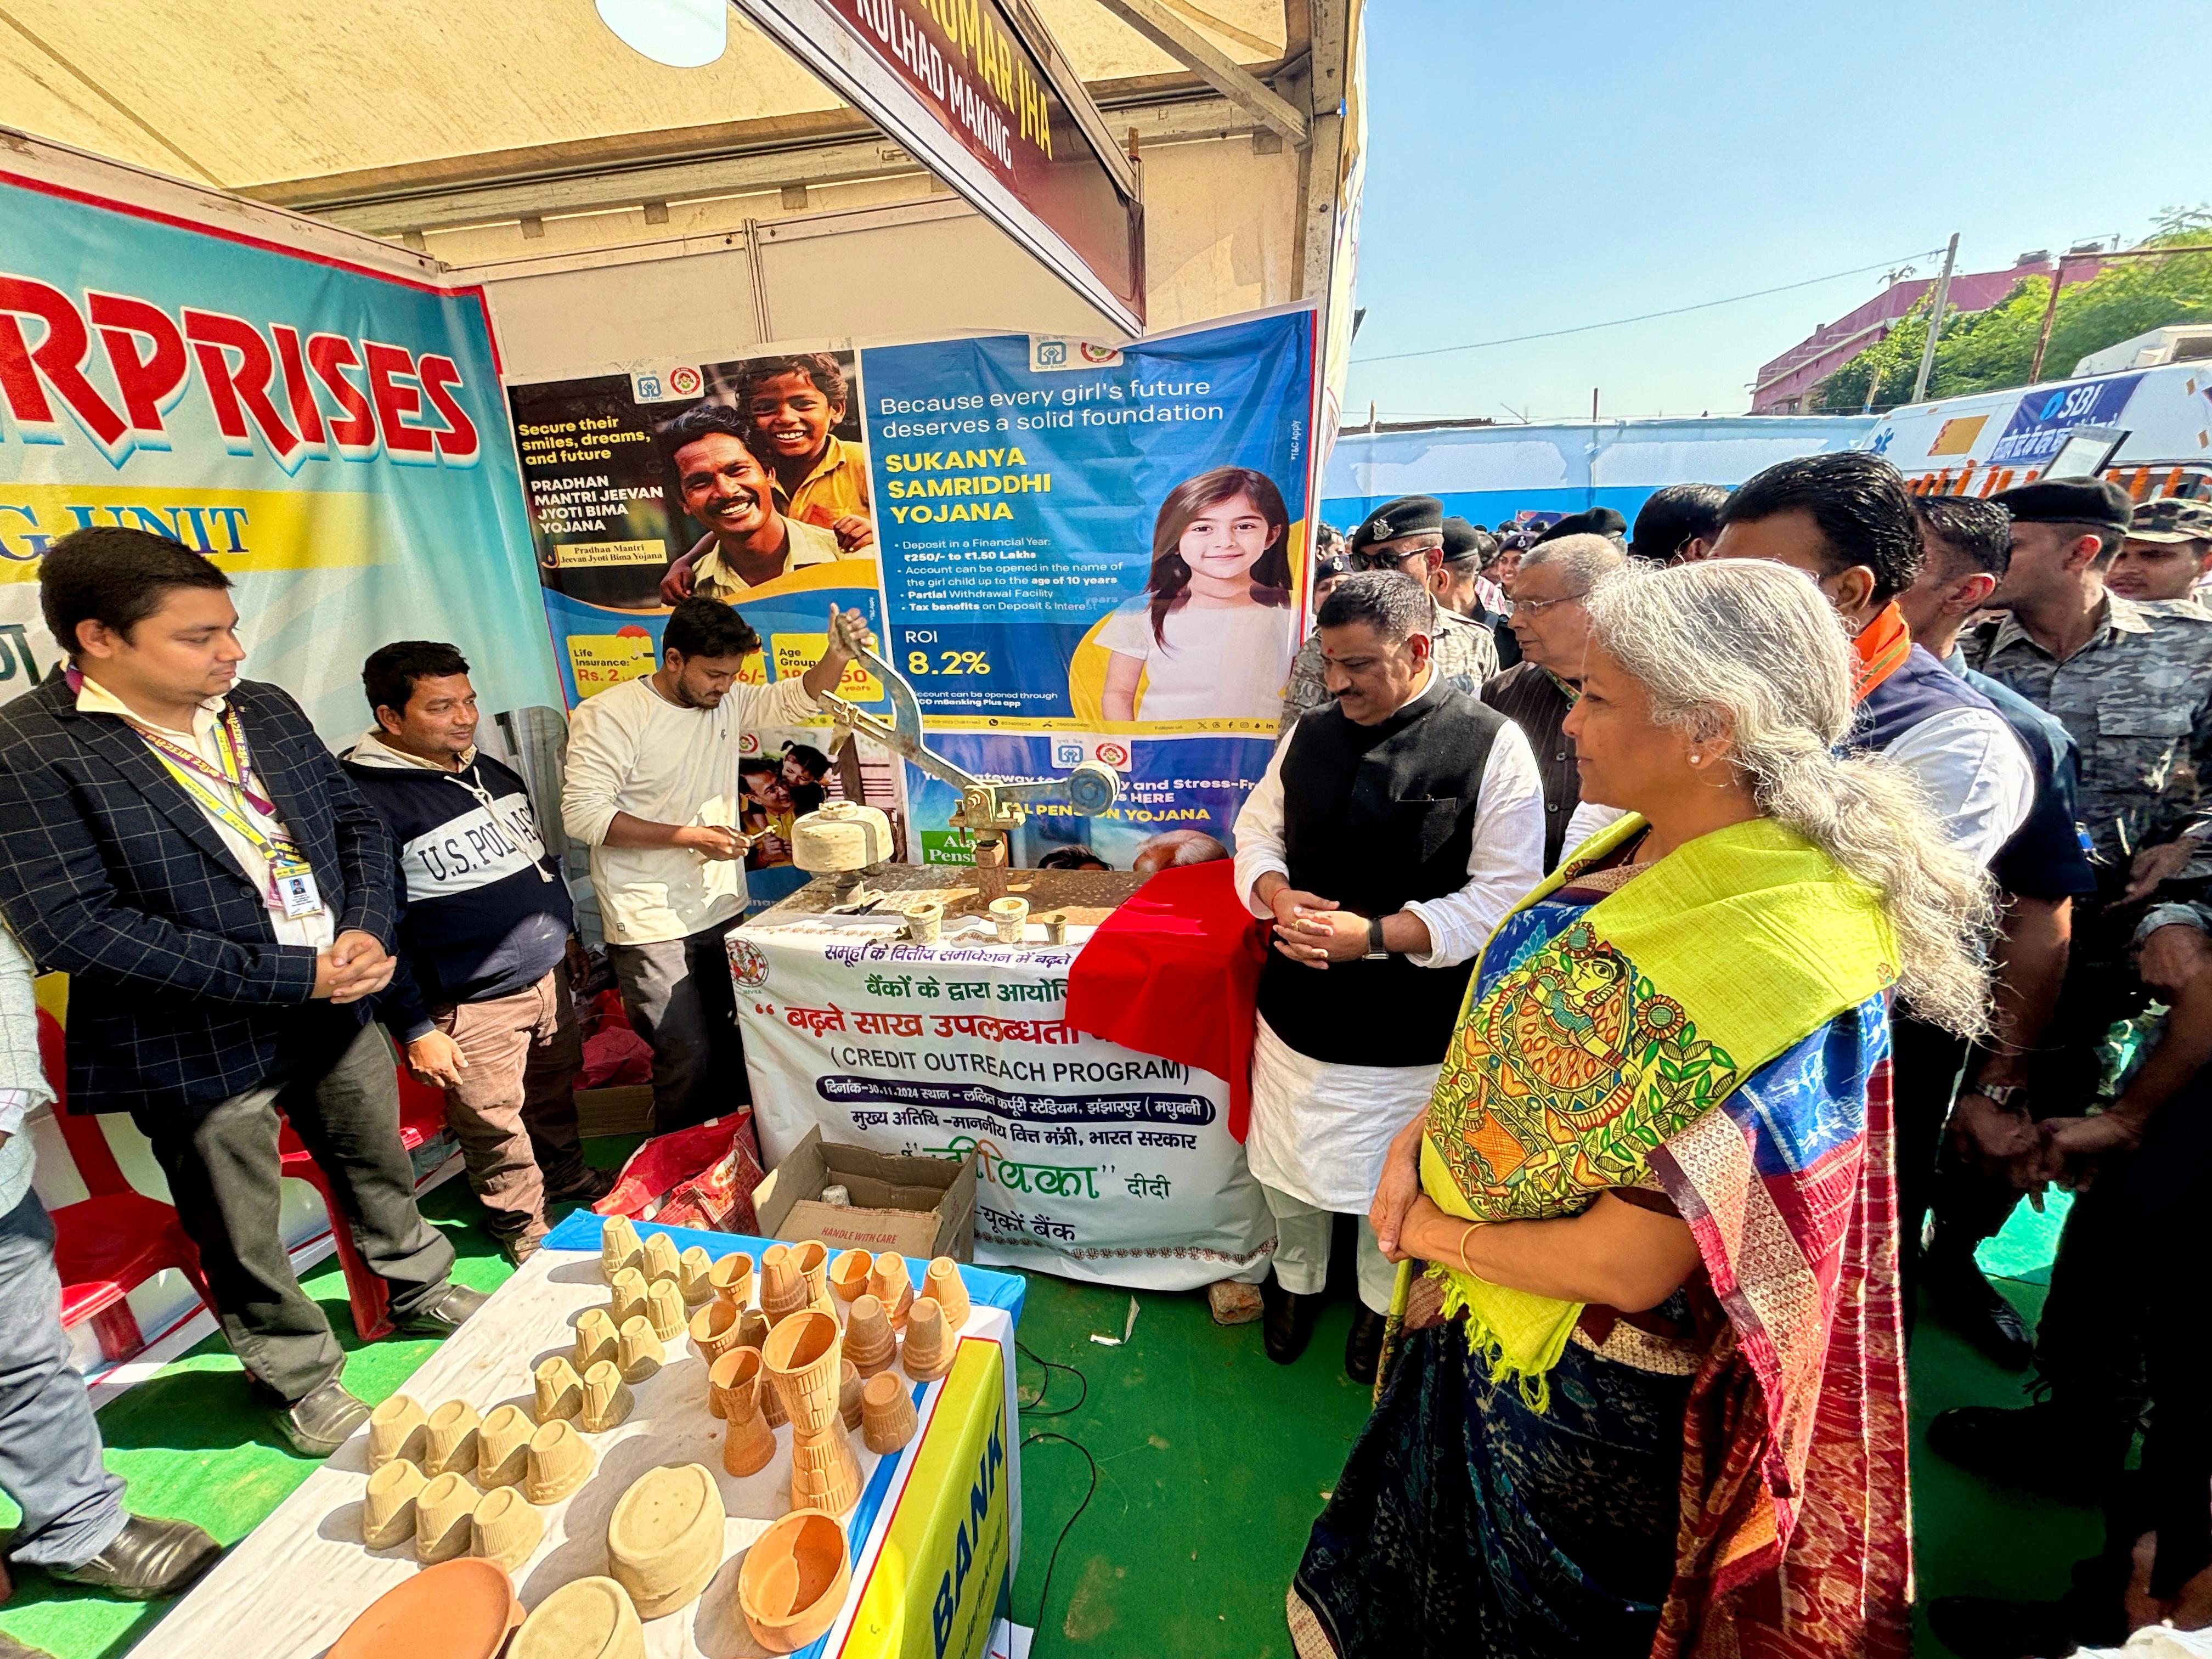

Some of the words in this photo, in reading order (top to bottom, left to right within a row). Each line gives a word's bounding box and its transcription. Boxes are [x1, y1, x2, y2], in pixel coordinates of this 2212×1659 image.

[921, 0, 1015, 115] UMAR
[947, 63, 1012, 170] MAKING
[881, 395, 984, 416] Because
[989, 389, 1054, 408] every
[1062, 382, 1124, 408] girl's
[1130, 379, 1211, 399] future
[2058, 383, 2104, 419] SBI
[518, 421, 577, 436] Secure
[578, 415, 619, 431] their
[883, 415, 990, 438] deserves
[995, 418, 1009, 431] a
[1017, 410, 1074, 430] solid
[1081, 403, 1223, 426] foundation
[1291, 420, 1302, 441] Apply
[522, 436, 579, 451] smiles,
[580, 430, 651, 447] dreams,
[525, 452, 557, 466] and
[560, 449, 612, 464] future
[885, 447, 1027, 473] SUKANYA
[531, 475, 610, 492] PRADHAN
[888, 473, 1052, 499] SAMRIDDHI
[534, 491, 597, 506] MANTRI
[600, 486, 664, 503] JEEVAN
[537, 506, 583, 521] JYOTI
[585, 503, 629, 518] BIMA
[889, 502, 1014, 524] YOJANA
[540, 520, 606, 534] YOJANA
[574, 546, 611, 555] Pradhan
[613, 544, 645, 552] Mantri
[902, 539, 947, 550] Deposit
[949, 540, 960, 548] in
[972, 538, 1024, 548] Financial
[1026, 538, 1051, 546] Year:
[588, 555, 608, 564] Jyoti
[904, 552, 945, 562] ₹250/-
[964, 551, 997, 560] ₹1.50
[1000, 550, 1036, 560] Lakhs
[905, 566, 953, 574] Account
[955, 566, 976, 574] can
[978, 564, 993, 573] be
[995, 563, 1037, 574] opened
[1040, 562, 1049, 572] in
[1051, 562, 1070, 572] the
[1071, 563, 1108, 571] name
[1109, 561, 1124, 571] of
[906, 578, 925, 586] the
[928, 577, 945, 588] girl
[947, 576, 975, 586] child
[978, 578, 992, 588] up
[1008, 576, 1028, 585] the
[1031, 577, 1050, 586] age
[1053, 575, 1064, 585] of
[1066, 575, 1080, 584] 10
[1082, 576, 1118, 586] years
[907, 590, 946, 599] Partial
[949, 589, 1012, 599] Withdrawal
[1014, 588, 1053, 600] Facility
[909, 603, 929, 612] Tax
[932, 602, 980, 612] benefits
[997, 601, 1042, 612] Deposit
[1045, 602, 1052, 610] &
[1054, 601, 1097, 611] Interest
[905, 630, 938, 644] ROI
[574, 648, 592, 658] Life
[779, 648, 802, 658] Age
[575, 658, 630, 667] Insurance:
[908, 650, 991, 675] 8.2%
[578, 669, 603, 681] Rs.
[608, 669, 619, 682] 2
[934, 698, 982, 707] mBanking
[1020, 691, 1058, 701] through
[974, 772, 1035, 783] ateway
[1133, 780, 1169, 791] and
[1173, 778, 1257, 792] Stress-Fr
[1130, 792, 1175, 804] HERE
[1036, 804, 1120, 819] PENN
[1124, 808, 1211, 822] YOJANA
[943, 834, 980, 848] Ata
[417, 837, 478, 881] U.S.
[929, 849, 977, 862] Pensi
[870, 943, 890, 961] के
[939, 949, 1011, 964] समावेशन
[1015, 951, 1036, 963] में
[864, 973, 913, 998] बैंकों
[915, 975, 940, 999] के
[945, 980, 990, 1002] द्वारा
[996, 978, 1069, 1002] आयोजि
[850, 1011, 924, 1037] साख
[929, 1014, 1080, 1045] उपलब्धता
[842, 1046, 917, 1070] CREDIT
[924, 1052, 1046, 1082] OUTREACH
[1053, 1059, 1190, 1086] PROGRAM)
[920, 1088, 950, 1101] स्थान
[962, 1087, 996, 1106] ललित
[1086, 1099, 1142, 1119] झंझारपुर
[1154, 1099, 1202, 1120] मधुबनी
[850, 1110, 888, 1131] मुख्य
[893, 1107, 940, 1126] अतिथि
[1009, 1123, 1041, 1143] वित्त
[1043, 1126, 1084, 1147] मंत्री,
[1088, 1130, 1133, 1146] भारत
[1137, 1131, 1198, 1150] सरकार
[1124, 1173, 1172, 1198] दीदी
[822, 1227, 854, 1240] HANDLE
[854, 1232, 876, 1243] WITH
[876, 1234, 898, 1244] CARE
[1030, 1215, 1076, 1242] बैंक
[933, 1402, 1003, 1659] BANK
